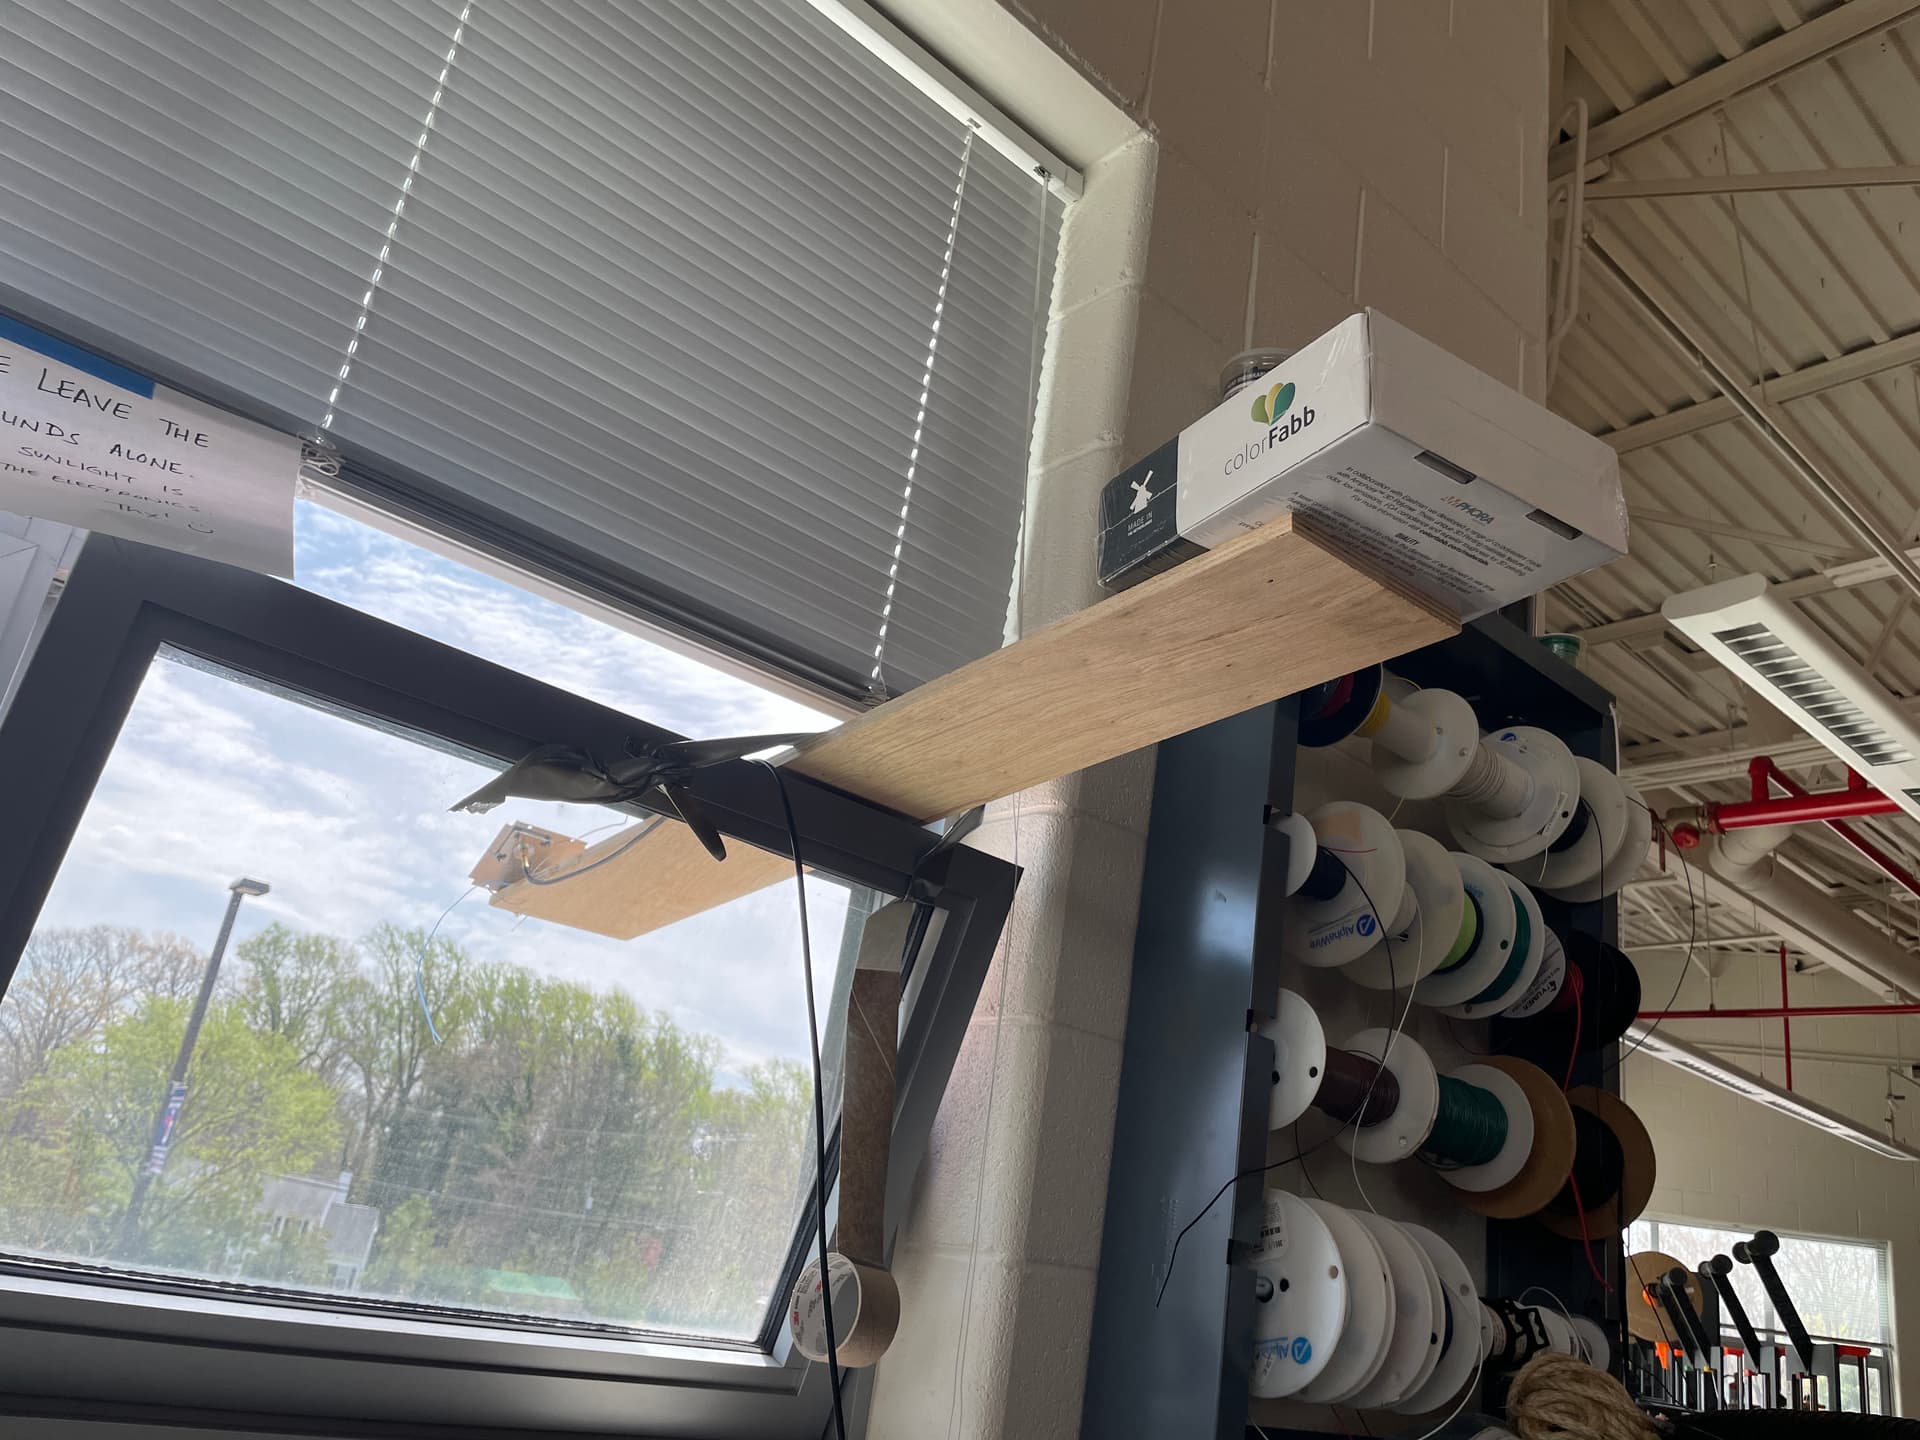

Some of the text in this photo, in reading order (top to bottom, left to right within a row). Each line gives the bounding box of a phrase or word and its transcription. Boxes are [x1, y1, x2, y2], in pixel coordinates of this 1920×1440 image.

[37, 367, 132, 420] LEAVE
[159, 417, 209, 448] THE
[1225, 406, 1316, 476] colorFabb
[18, 446, 183, 497] SUNLIGHT IS
